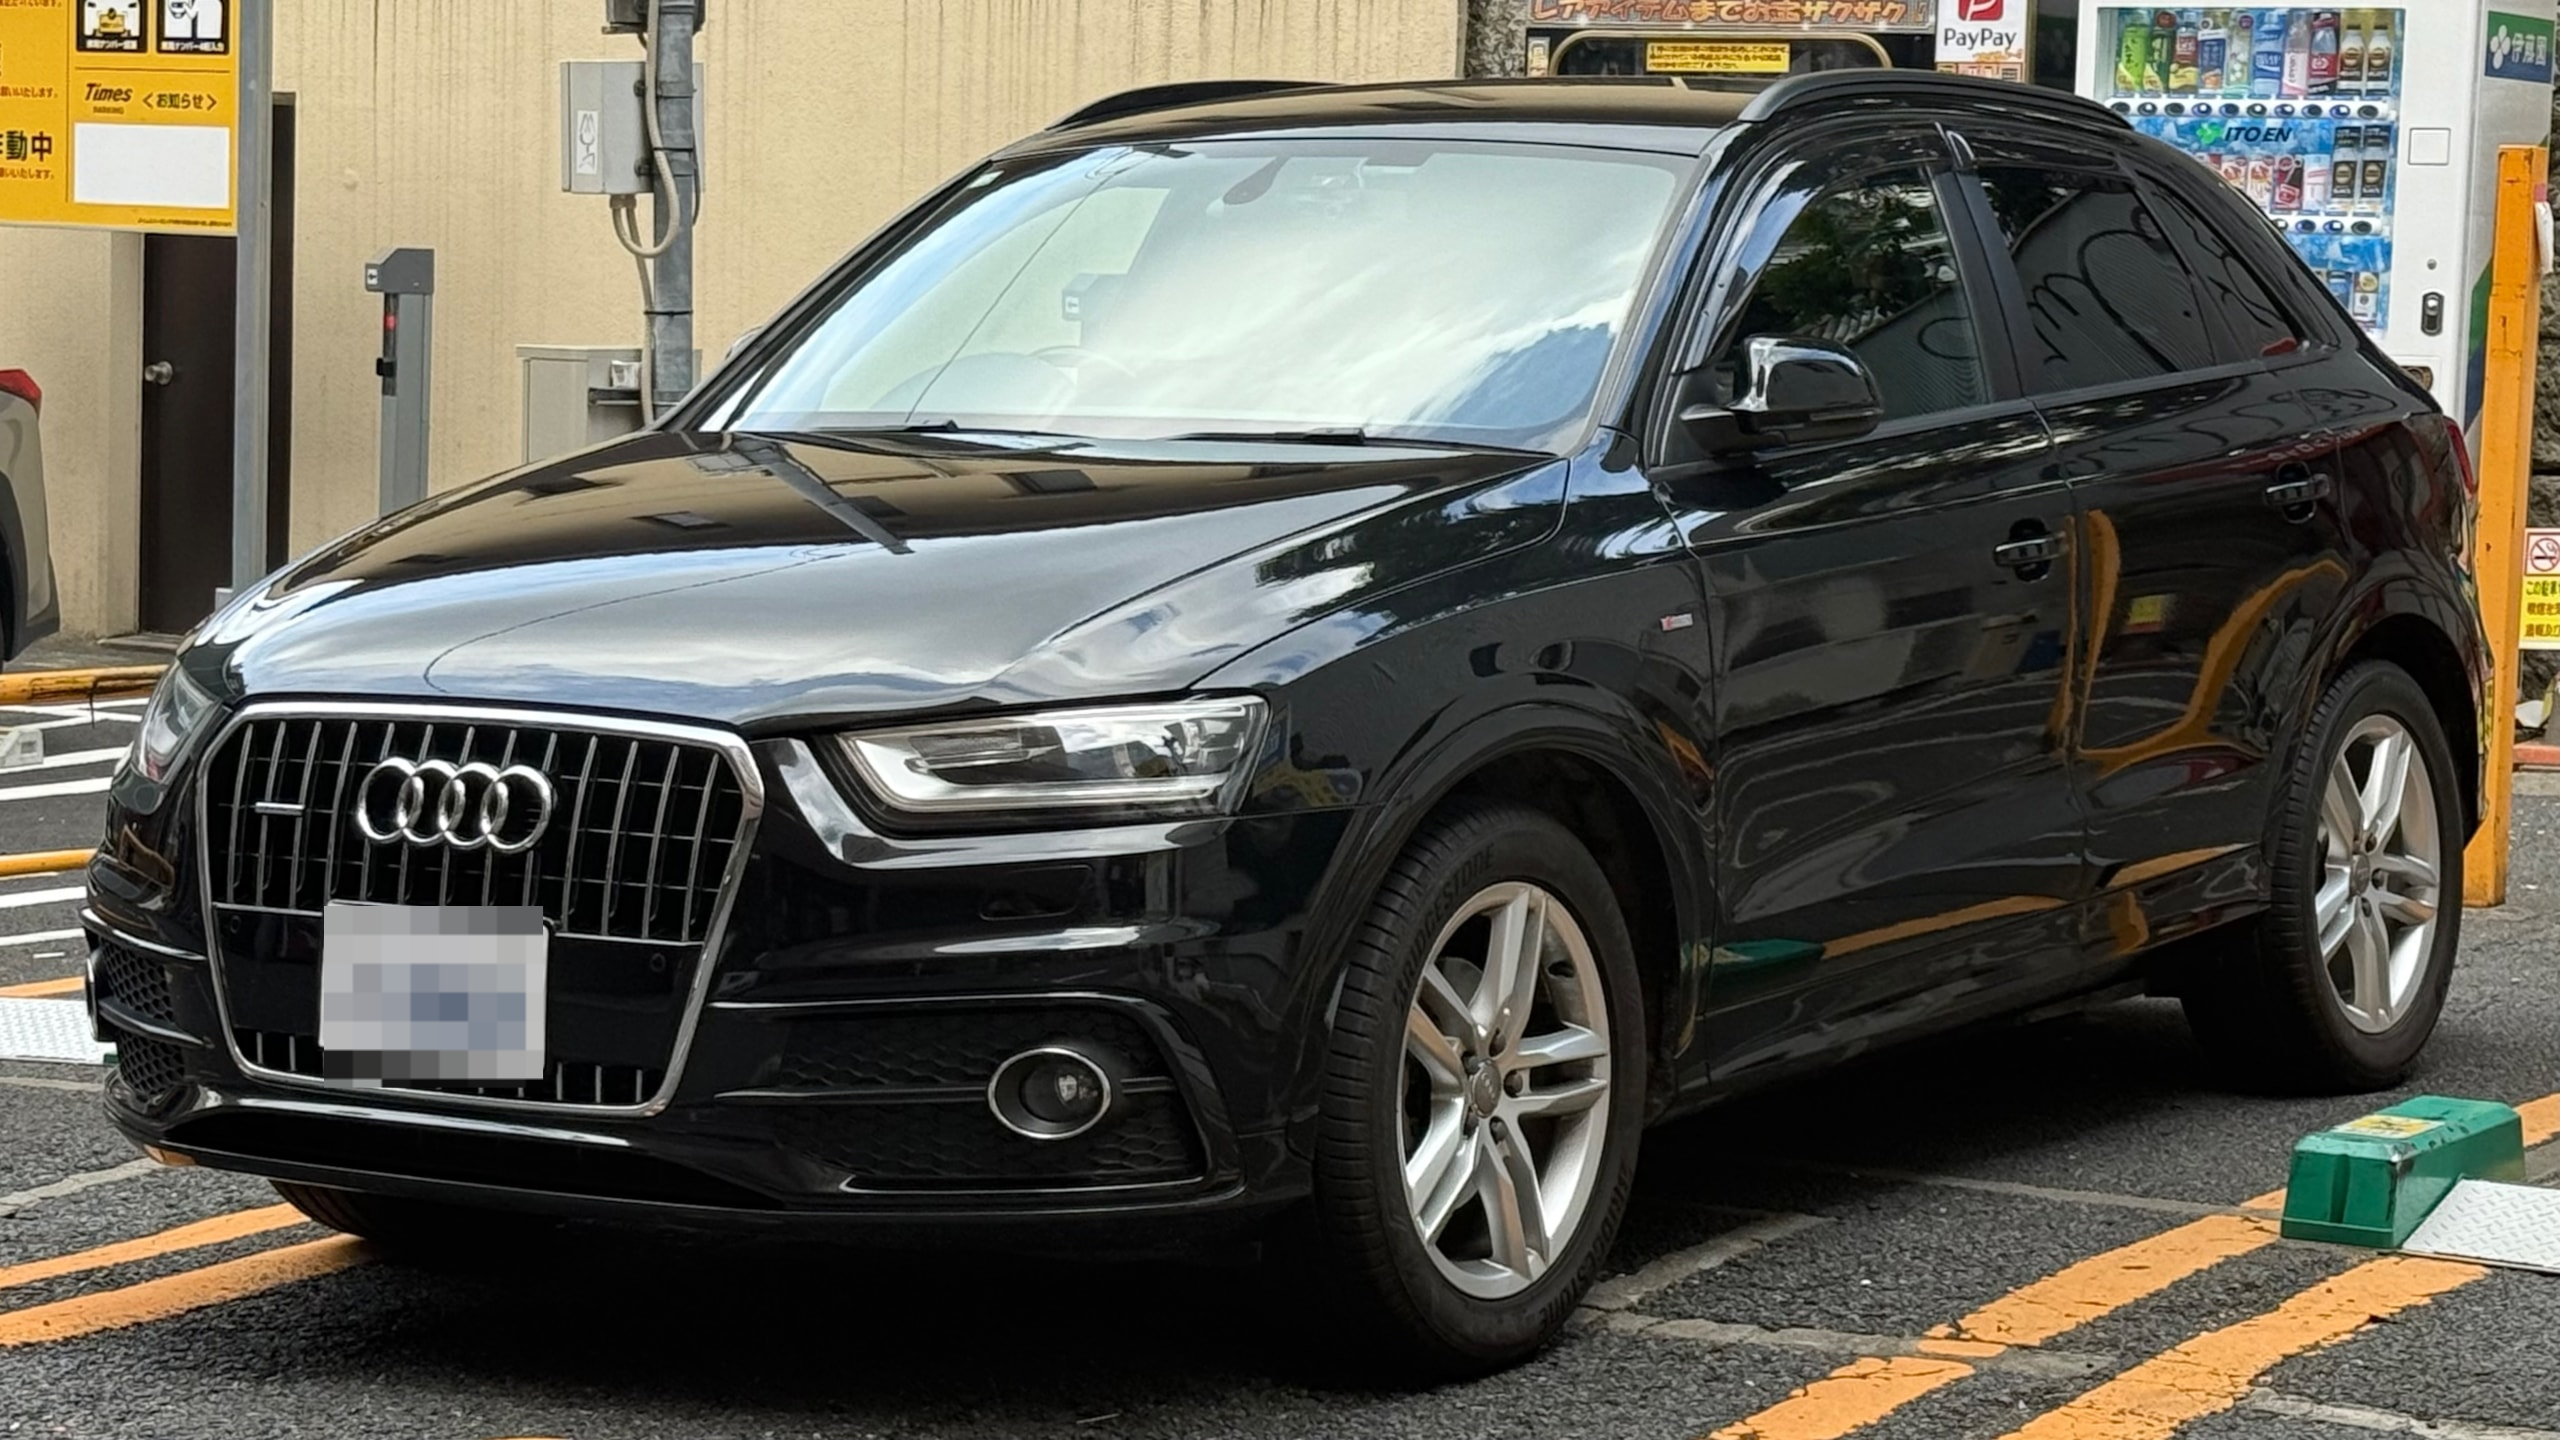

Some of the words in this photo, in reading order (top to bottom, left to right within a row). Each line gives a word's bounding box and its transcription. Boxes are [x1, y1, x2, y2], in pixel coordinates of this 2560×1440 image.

[1944, 27, 2017, 51] PayPay
[85, 82, 133, 102] Times
[0, 131, 53, 162] 動中
[2224, 126, 2260, 142] ITO
[2262, 127, 2293, 143] EN
[1394, 842, 1496, 1013] BRIDGESTONE
